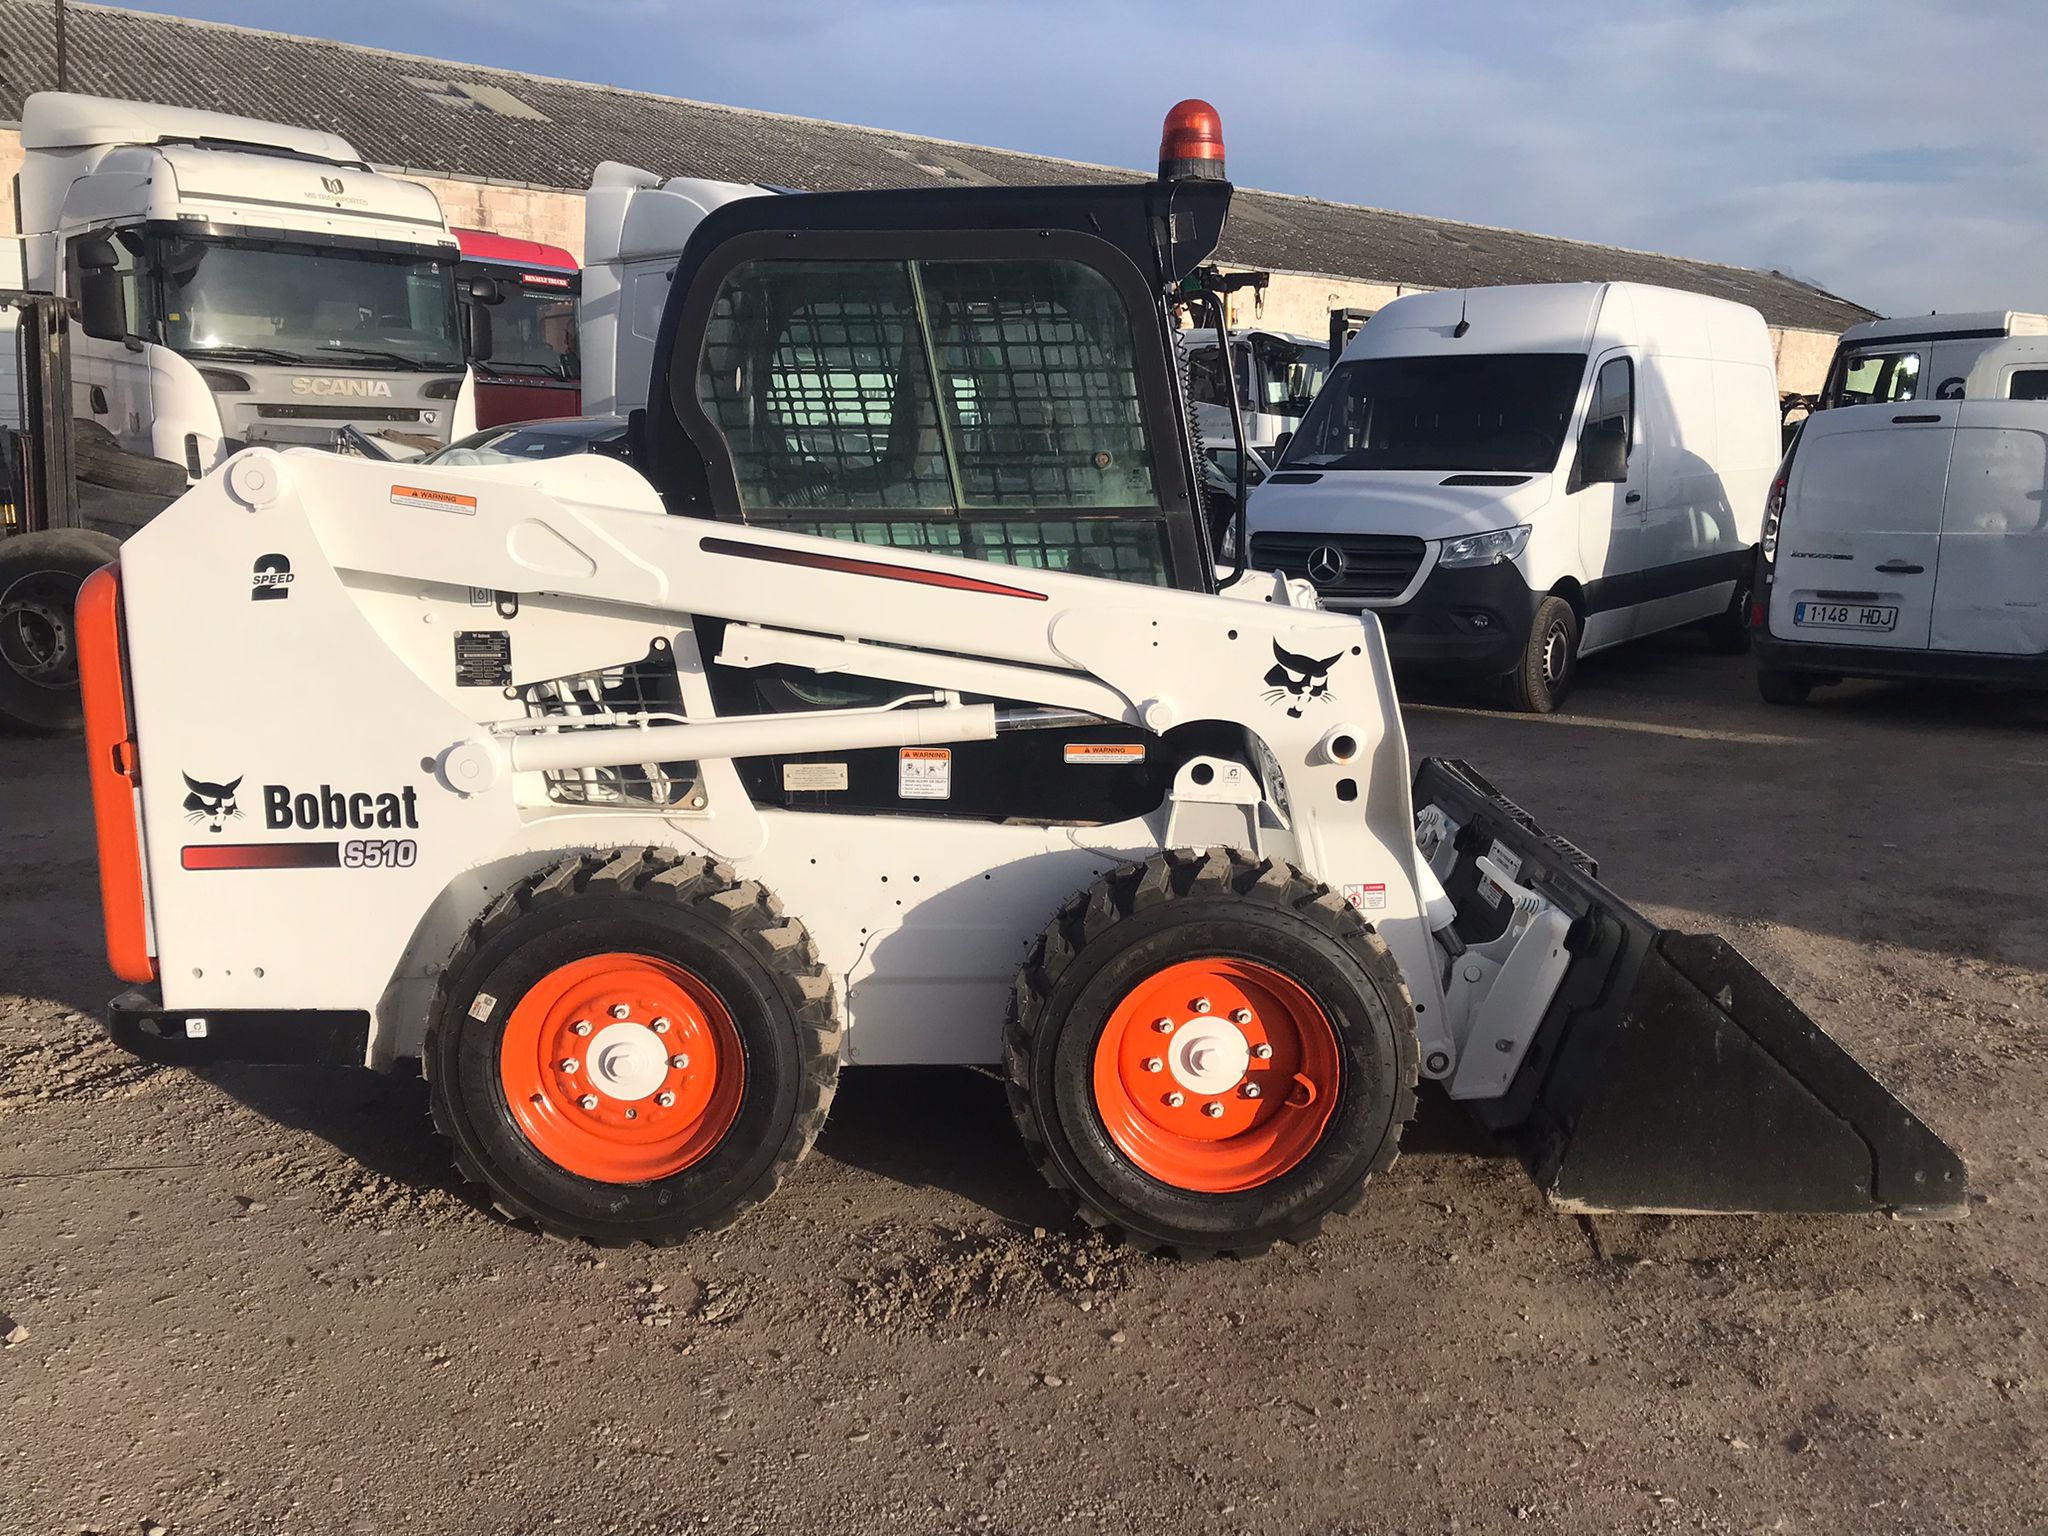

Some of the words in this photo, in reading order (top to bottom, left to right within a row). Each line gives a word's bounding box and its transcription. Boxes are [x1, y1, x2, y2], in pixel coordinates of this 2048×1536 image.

[317, 194, 369, 206] TRANSPORTES
[292, 377, 392, 397] SCANIA
[420, 491, 457, 503] WARNING
[251, 553, 291, 601] 2
[252, 573, 295, 585] SPEED
[1811, 606, 1848, 623] 1148
[1859, 608, 1893, 626] HDJ
[912, 751, 947, 759] WARNING
[263, 784, 419, 830] Bobcat
[344, 839, 417, 868] S510
